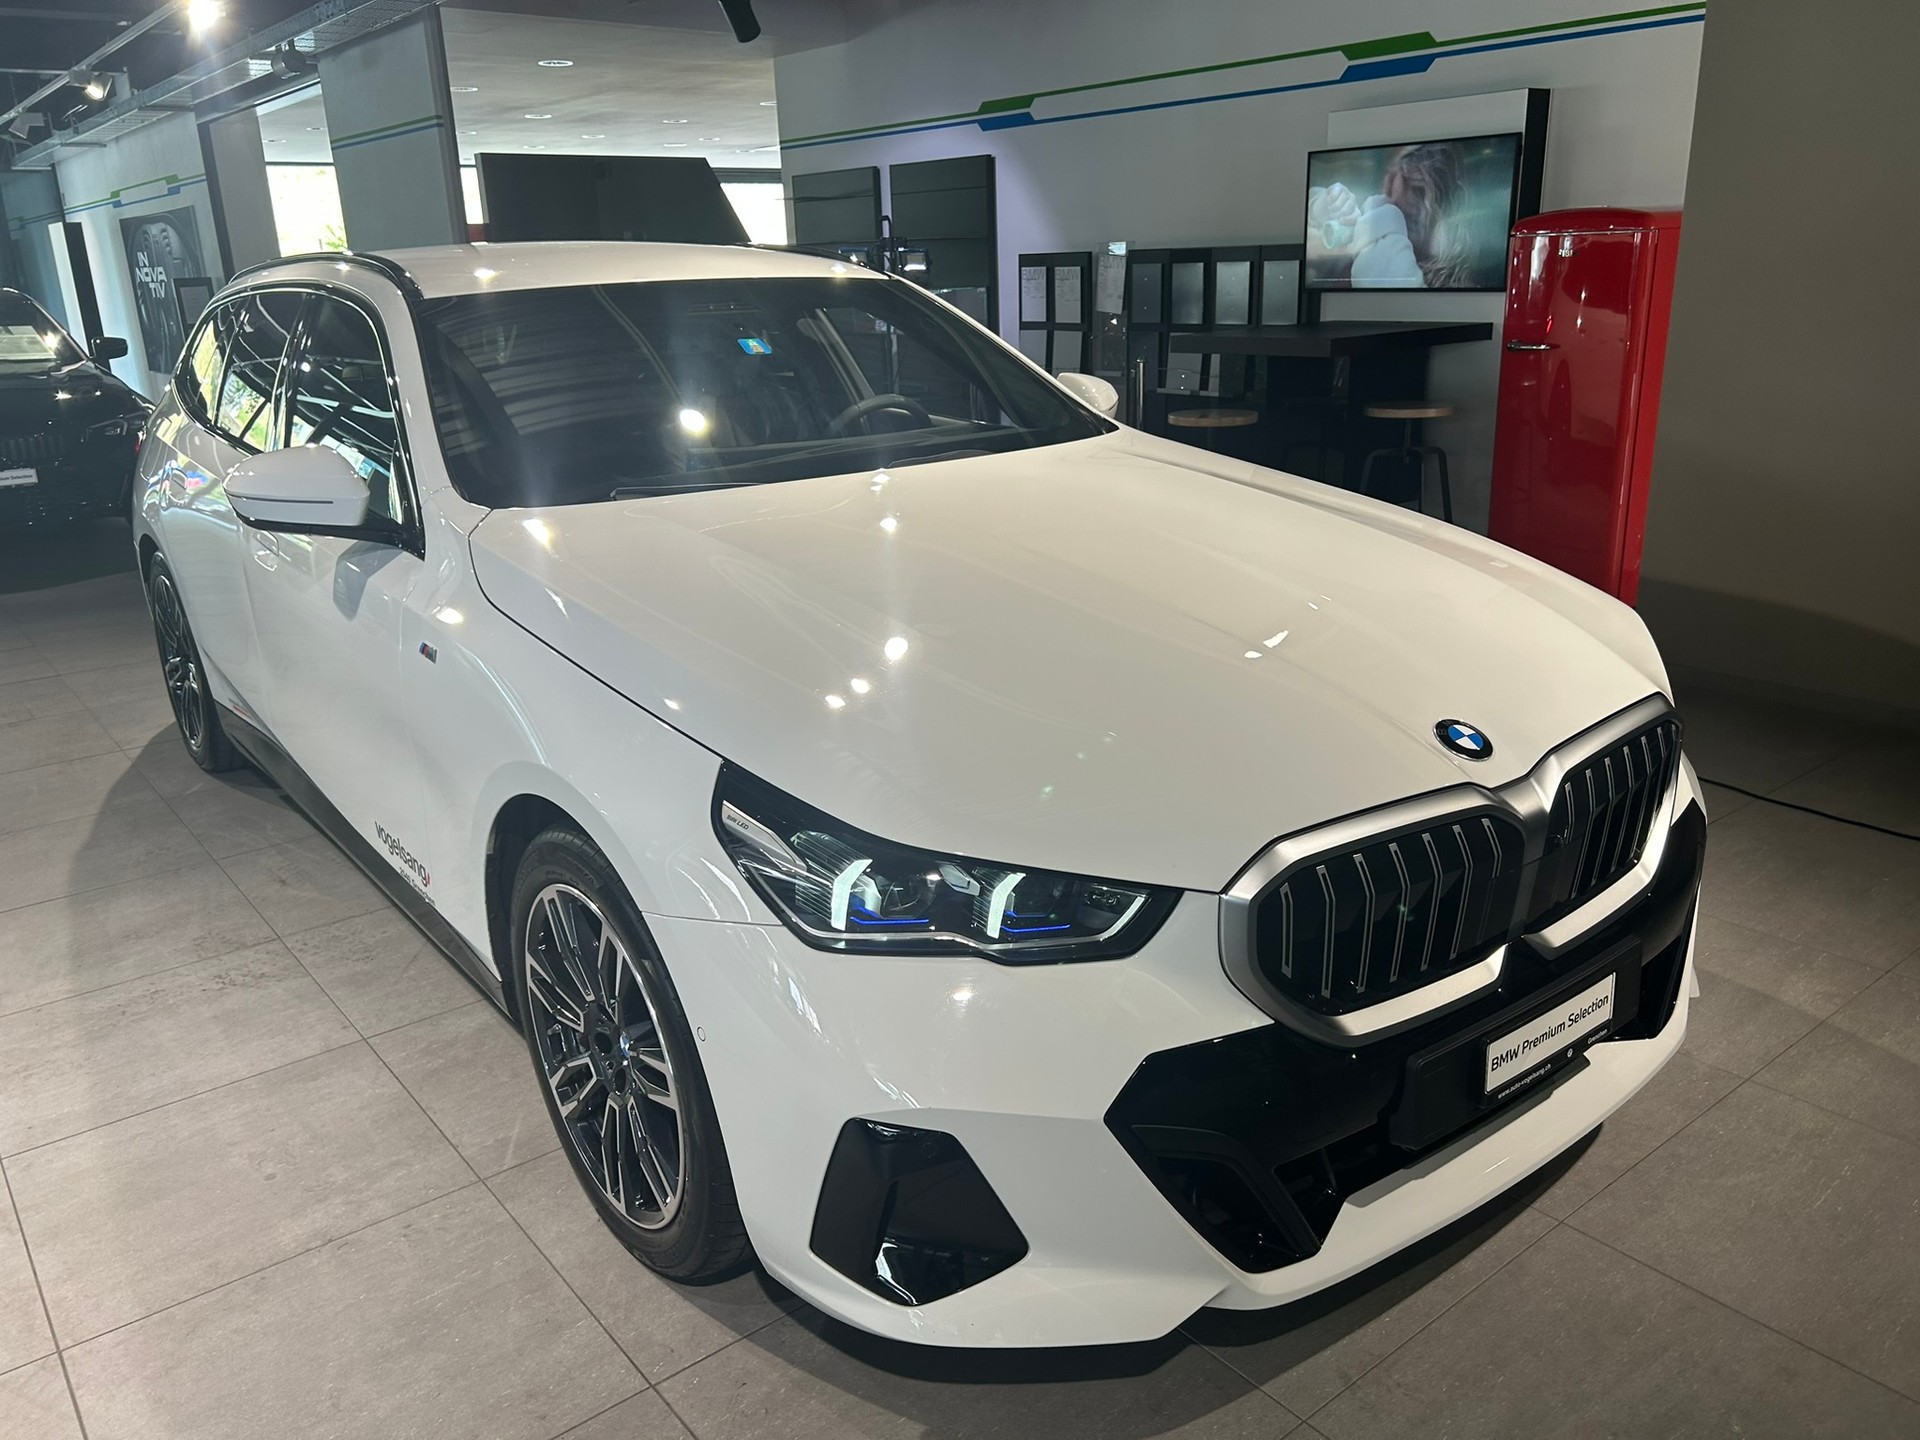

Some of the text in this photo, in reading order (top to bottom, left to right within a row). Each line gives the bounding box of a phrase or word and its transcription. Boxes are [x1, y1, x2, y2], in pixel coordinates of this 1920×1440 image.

[137, 252, 149, 267] IN
[136, 266, 167, 282] NOVA
[148, 282, 165, 298] TIV
[736, 821, 749, 829] LED
[375, 820, 428, 888] vogelsang
[1491, 994, 1609, 1072] BMW Premium Selection
